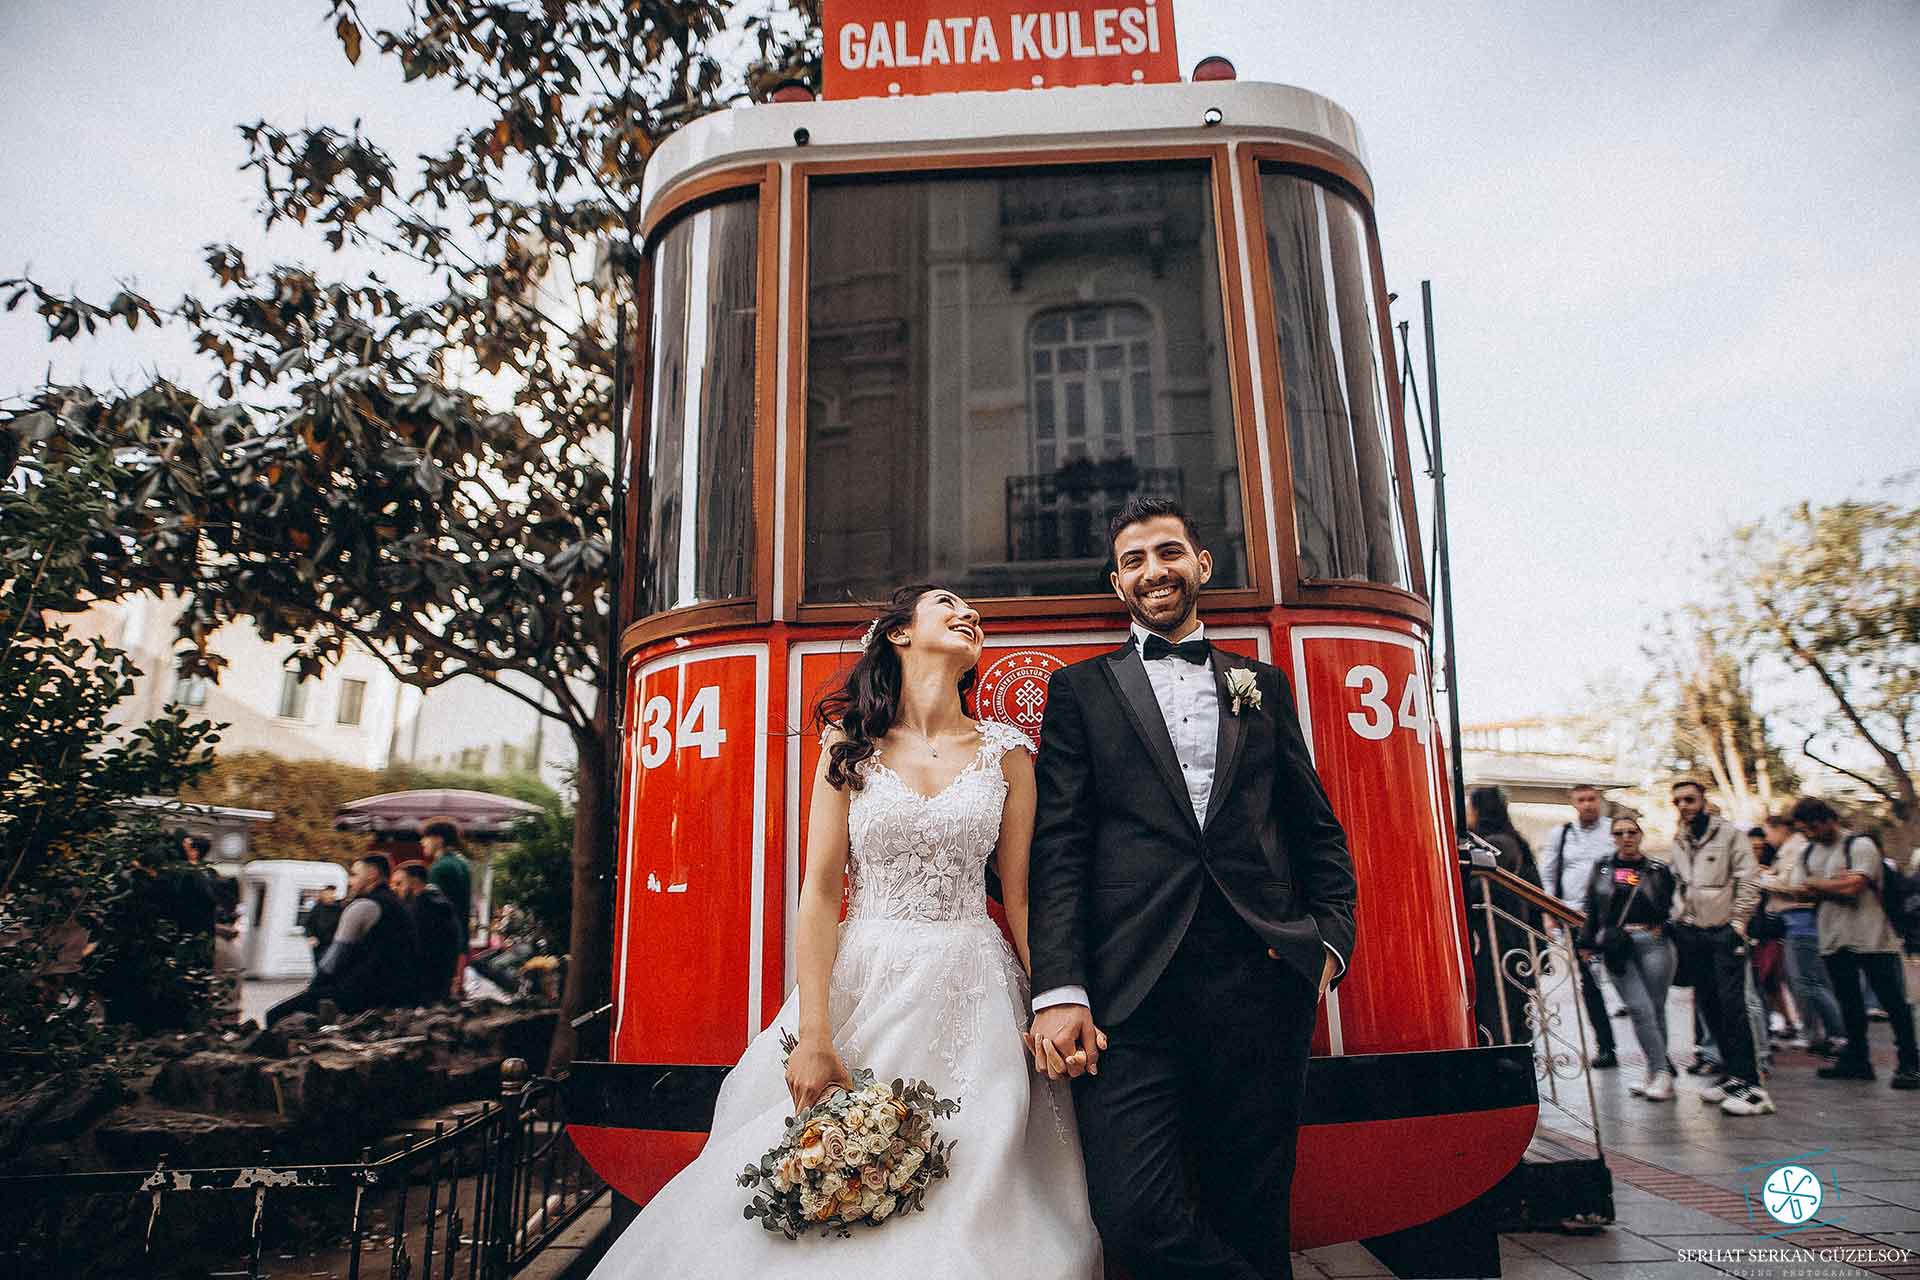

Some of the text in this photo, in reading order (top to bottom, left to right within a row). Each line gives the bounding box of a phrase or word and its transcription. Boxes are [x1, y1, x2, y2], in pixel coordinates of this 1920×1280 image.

[839, 0, 1161, 70] GALATA KULESİ
[640, 685, 727, 770] 34
[1344, 664, 1426, 745] 34
